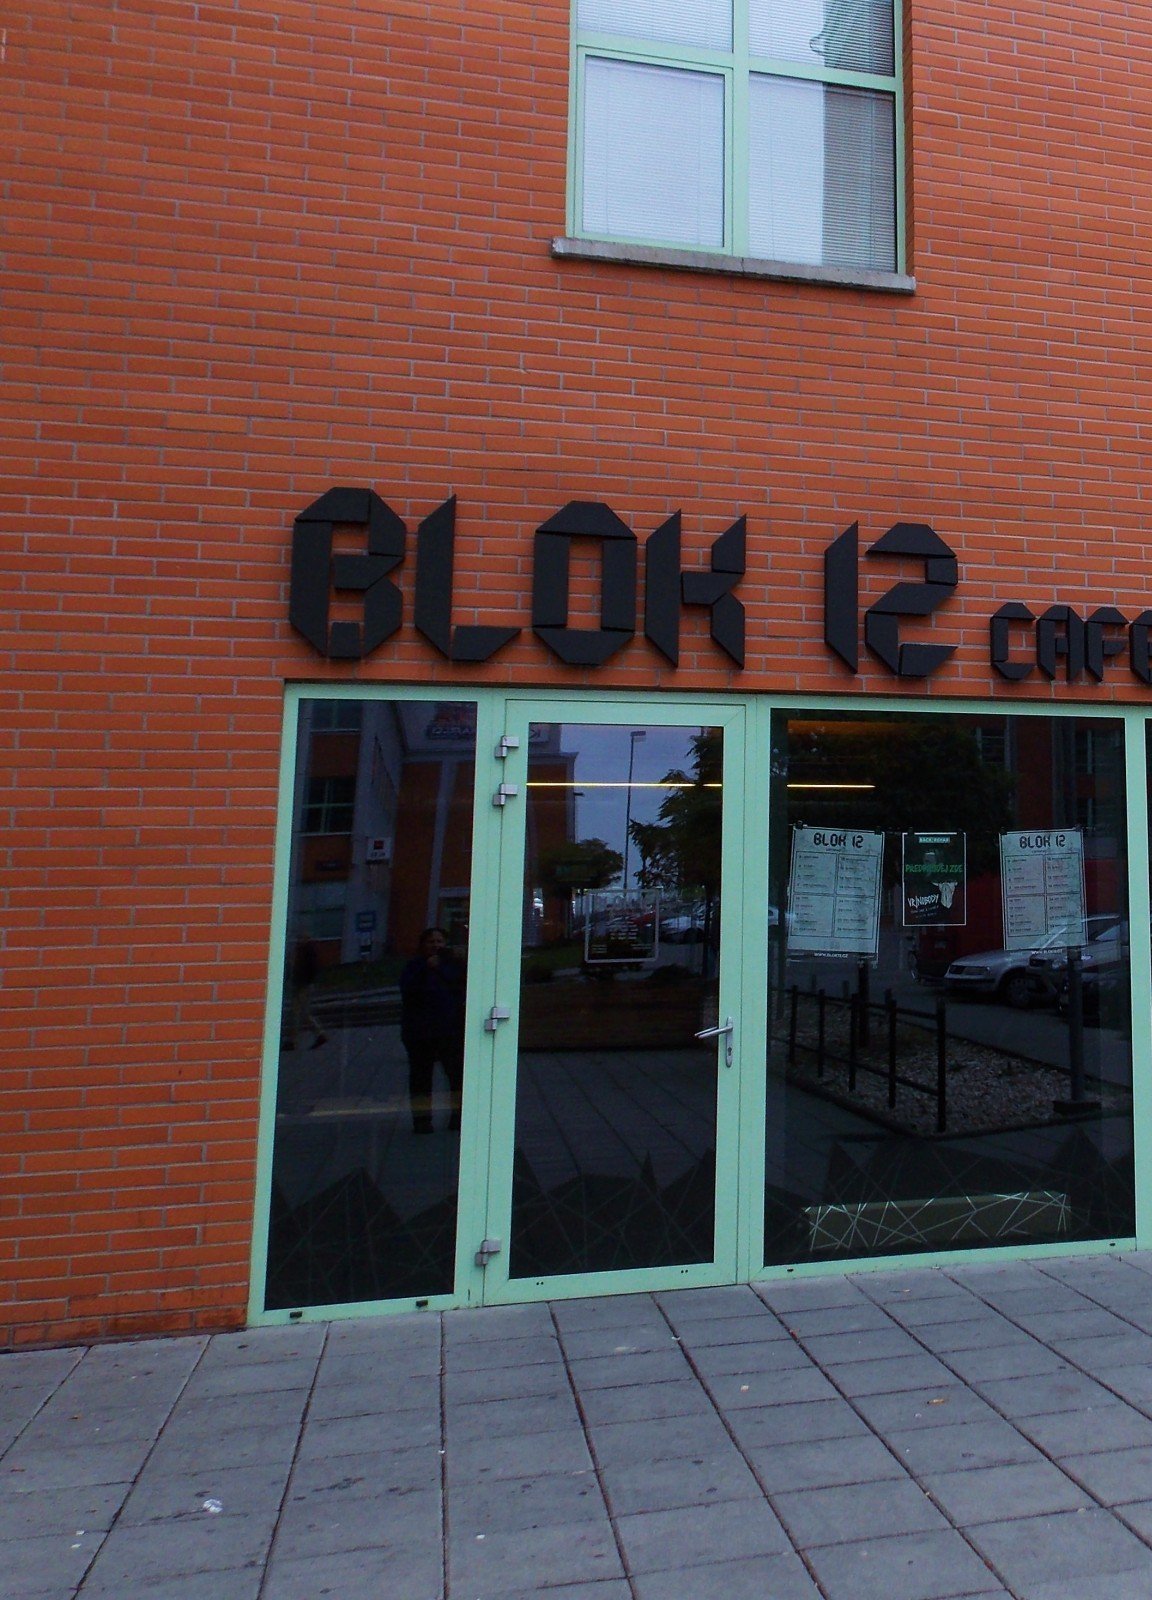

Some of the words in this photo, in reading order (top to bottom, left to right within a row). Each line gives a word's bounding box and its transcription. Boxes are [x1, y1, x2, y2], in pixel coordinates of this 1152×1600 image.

[288, 486, 747, 670] BLOK
[824, 520, 959, 677] 12
[813, 832, 846, 847] BLOK
[852, 836, 864, 849] 12
[1019, 834, 1051, 849] BLOK
[1056, 834, 1066, 848] 12
